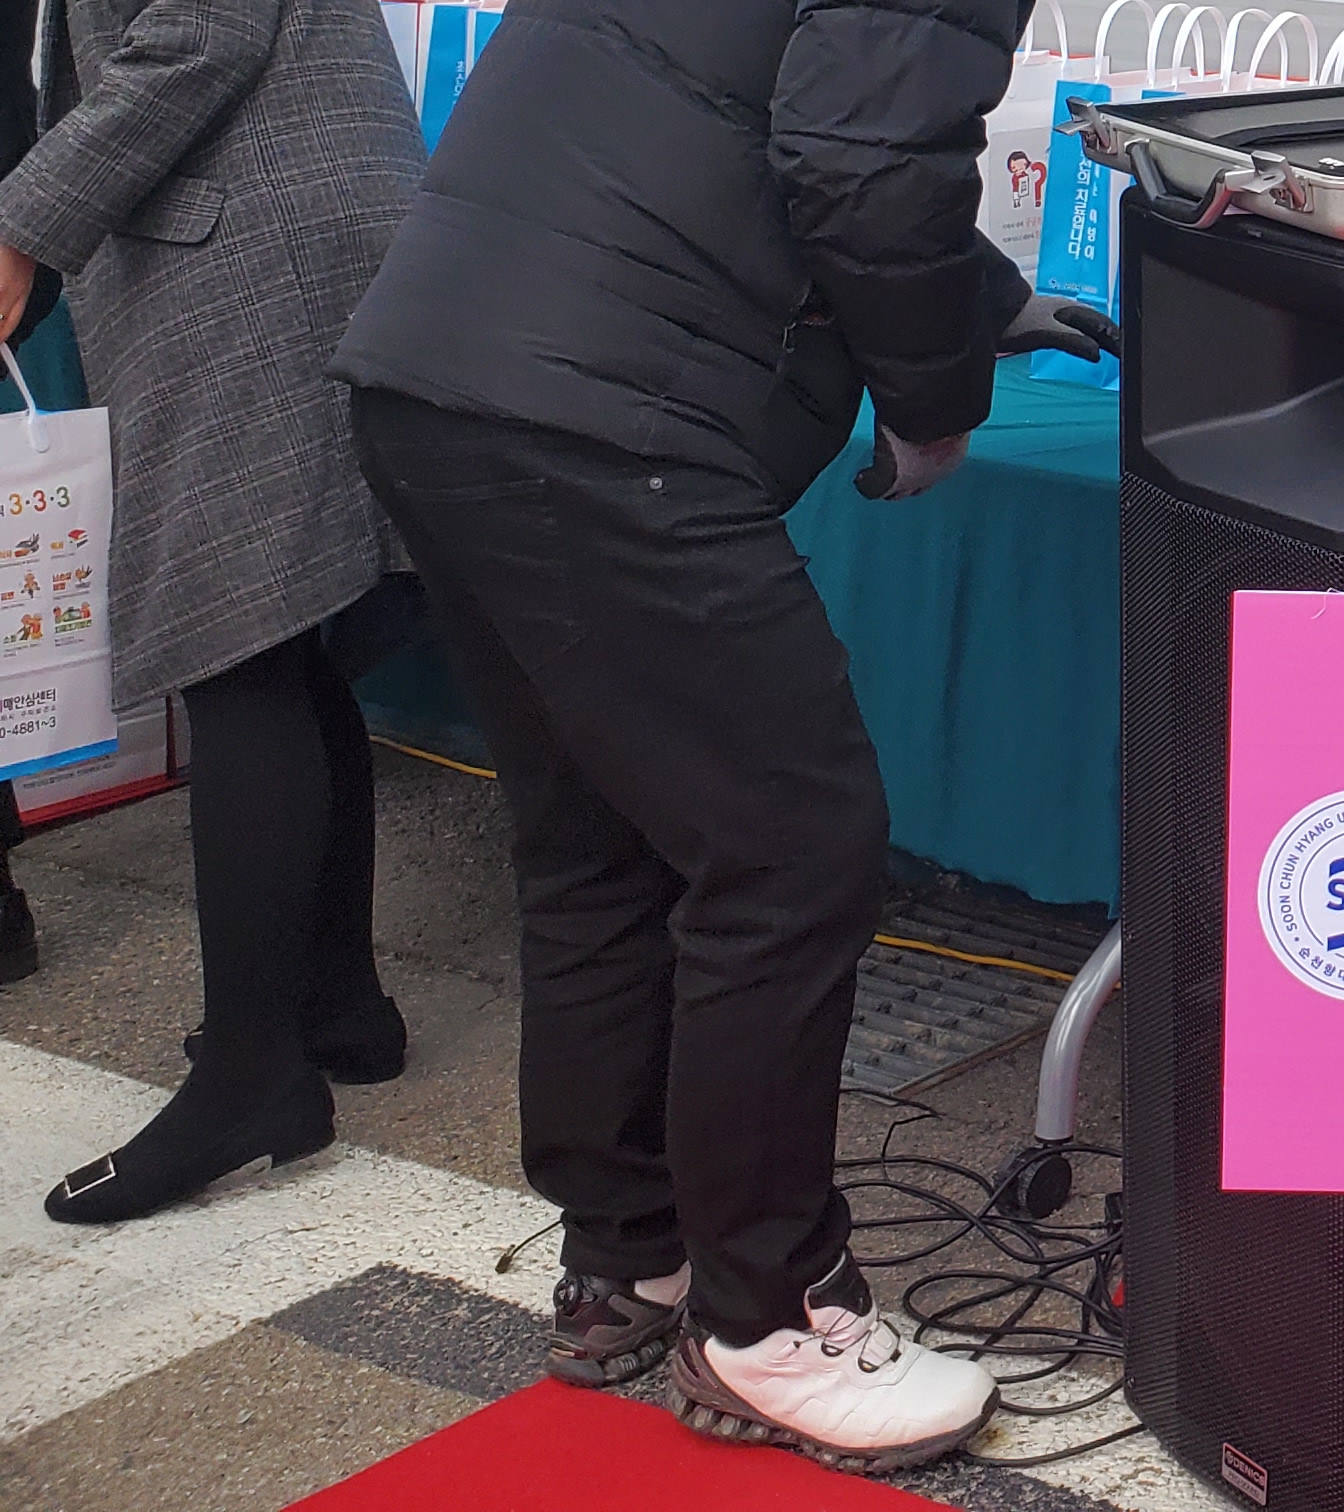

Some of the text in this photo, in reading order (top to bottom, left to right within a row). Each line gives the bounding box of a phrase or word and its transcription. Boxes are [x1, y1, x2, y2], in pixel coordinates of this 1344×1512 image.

[0, 688, 56, 715] 매안심센터
[1294, 818, 1334, 854] HYANG
[1280, 853, 1300, 890] CHUN
[1279, 895, 1298, 932] SOON
